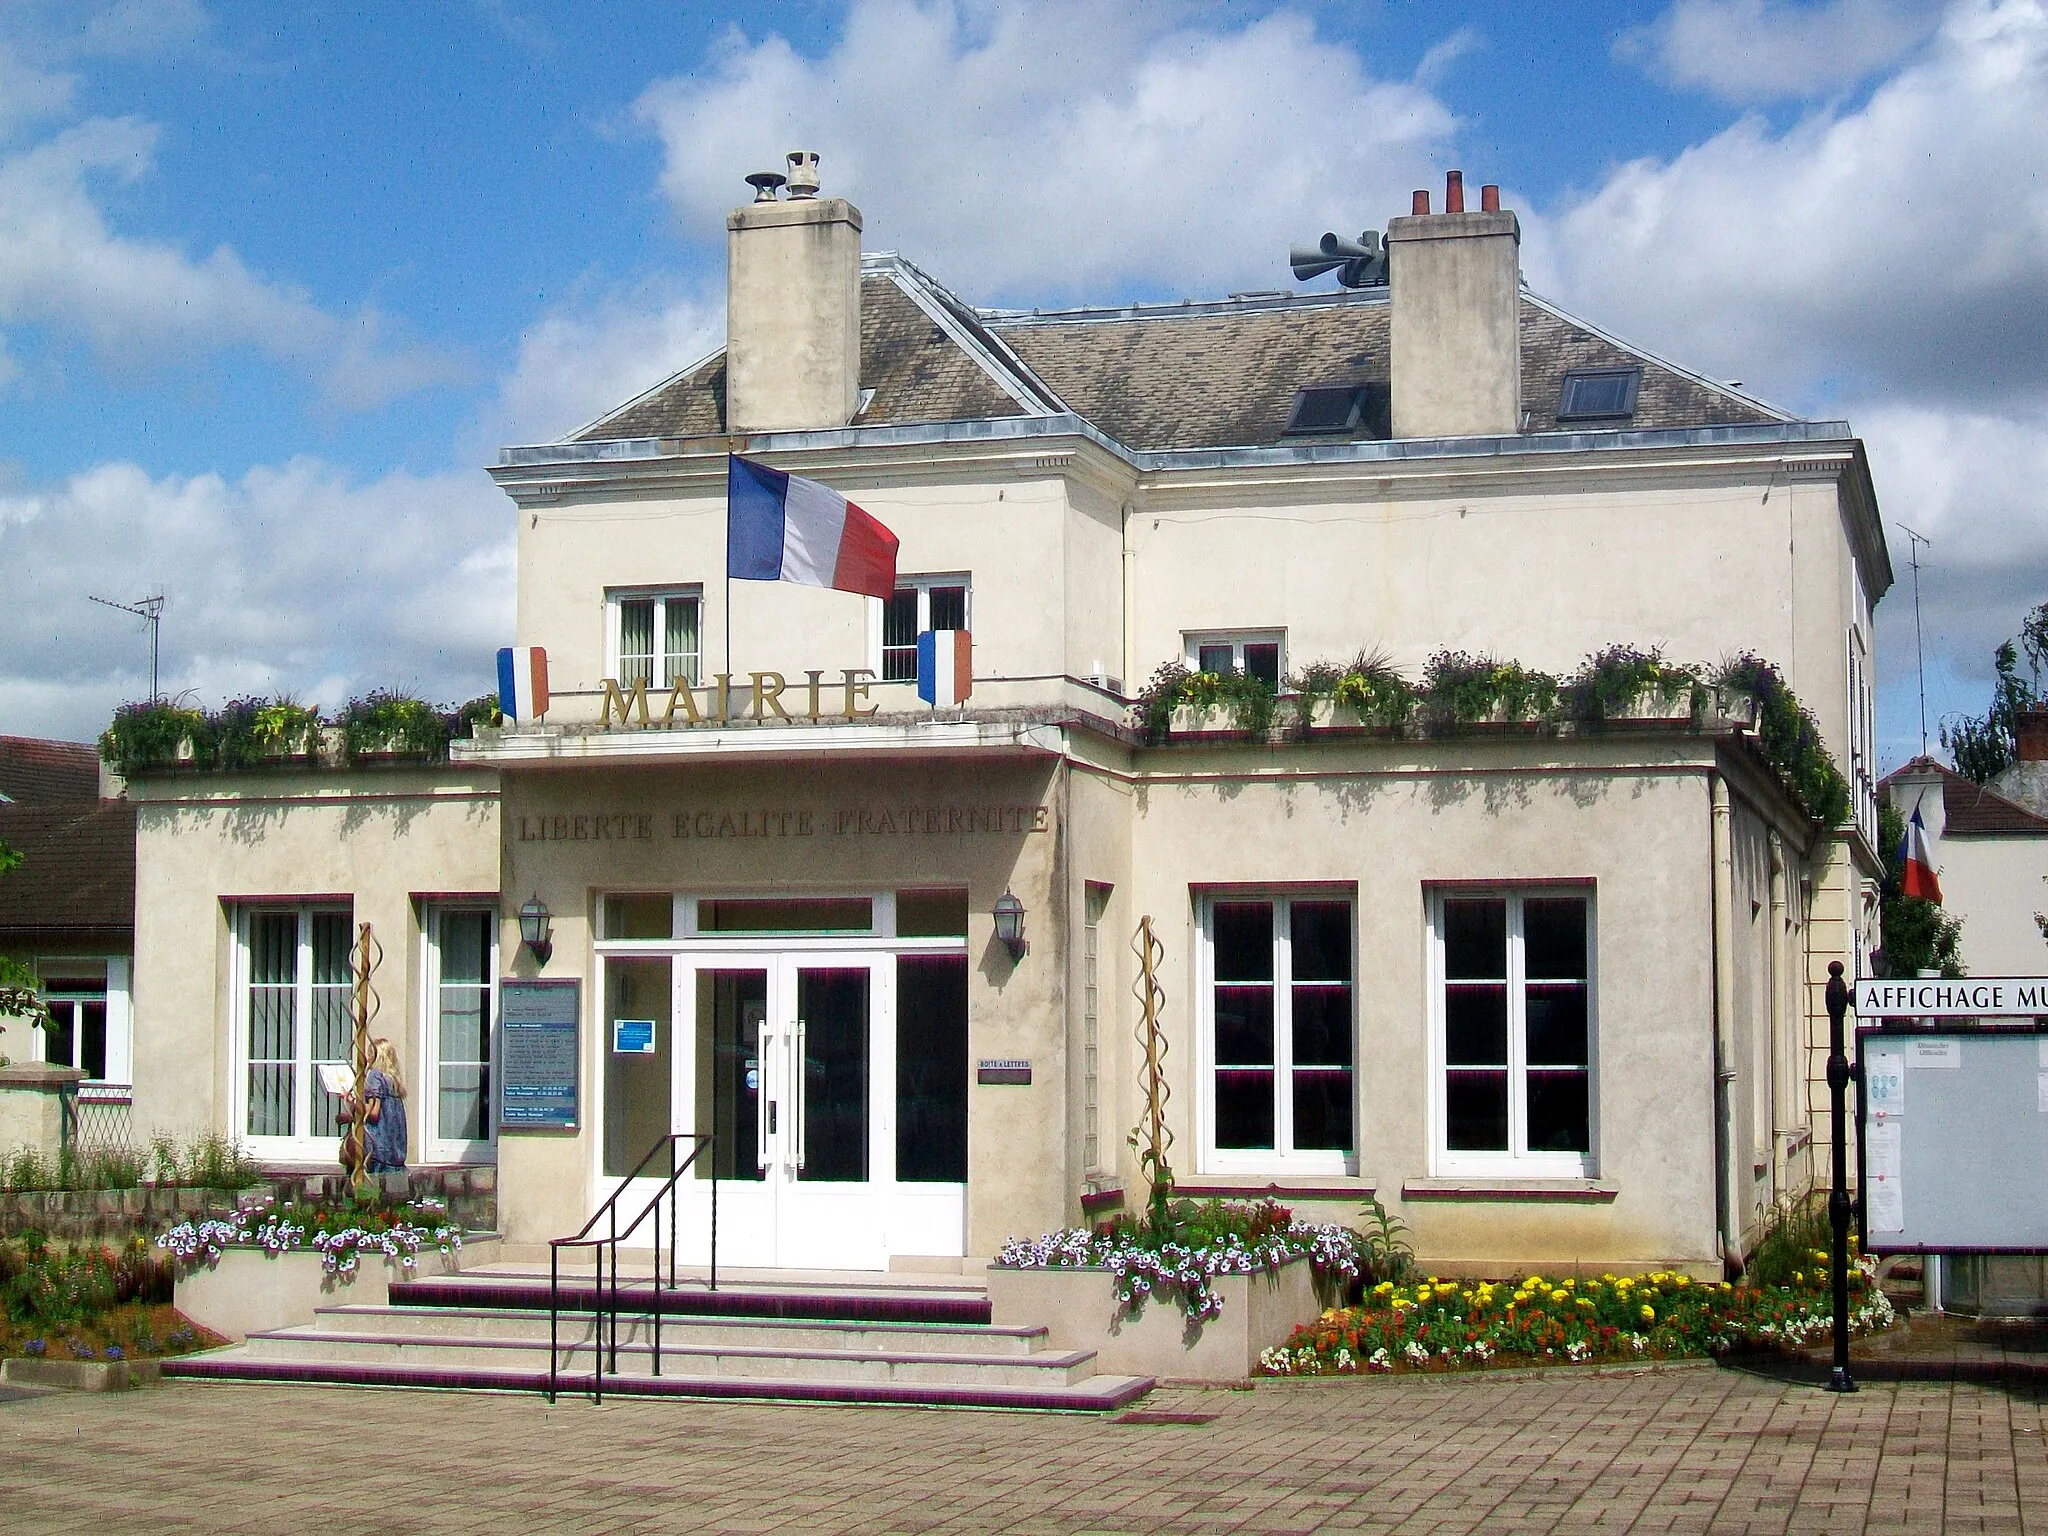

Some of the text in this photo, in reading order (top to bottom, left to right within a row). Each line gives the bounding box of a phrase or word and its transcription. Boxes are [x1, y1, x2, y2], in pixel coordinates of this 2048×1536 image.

[597, 669, 880, 725] MAIRIE
[518, 805, 1049, 841] LIBERTE EGALITE FRATERNITE
[1865, 986, 2004, 1008] AFFICHAGE
